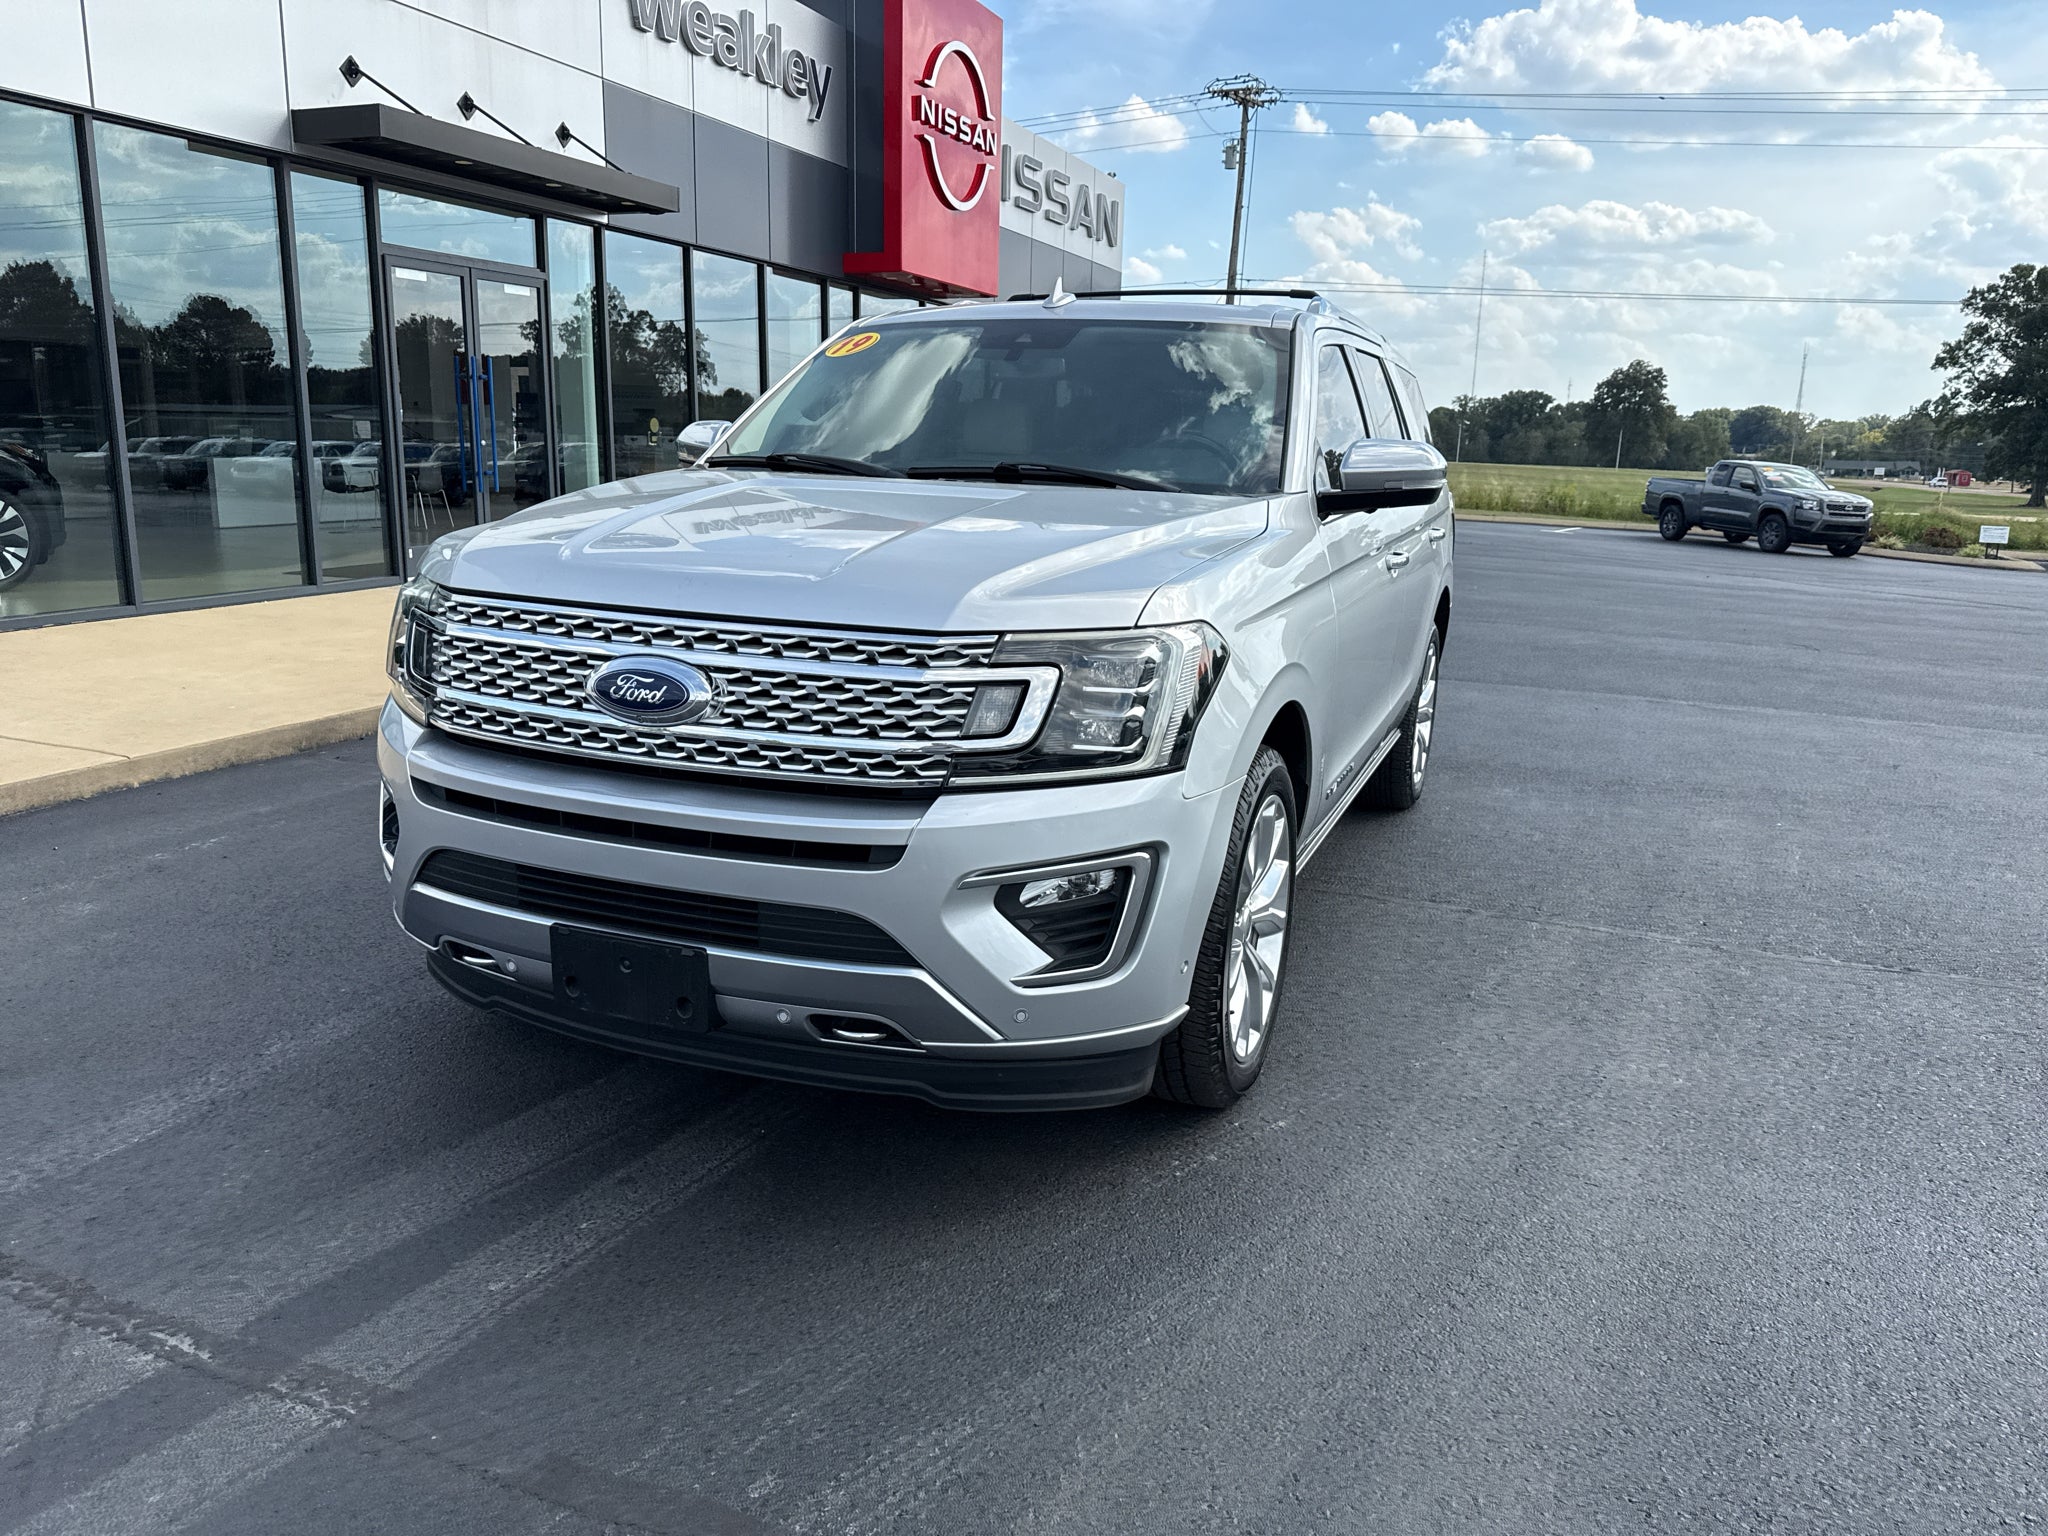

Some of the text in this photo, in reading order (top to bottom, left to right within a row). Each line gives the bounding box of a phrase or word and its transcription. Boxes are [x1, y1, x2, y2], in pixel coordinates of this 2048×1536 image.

[919, 94, 997, 157] NISSAN
[1001, 144, 1119, 248] ISSAN
[831, 335, 874, 355] 19
[610, 673, 668, 705] Ford
